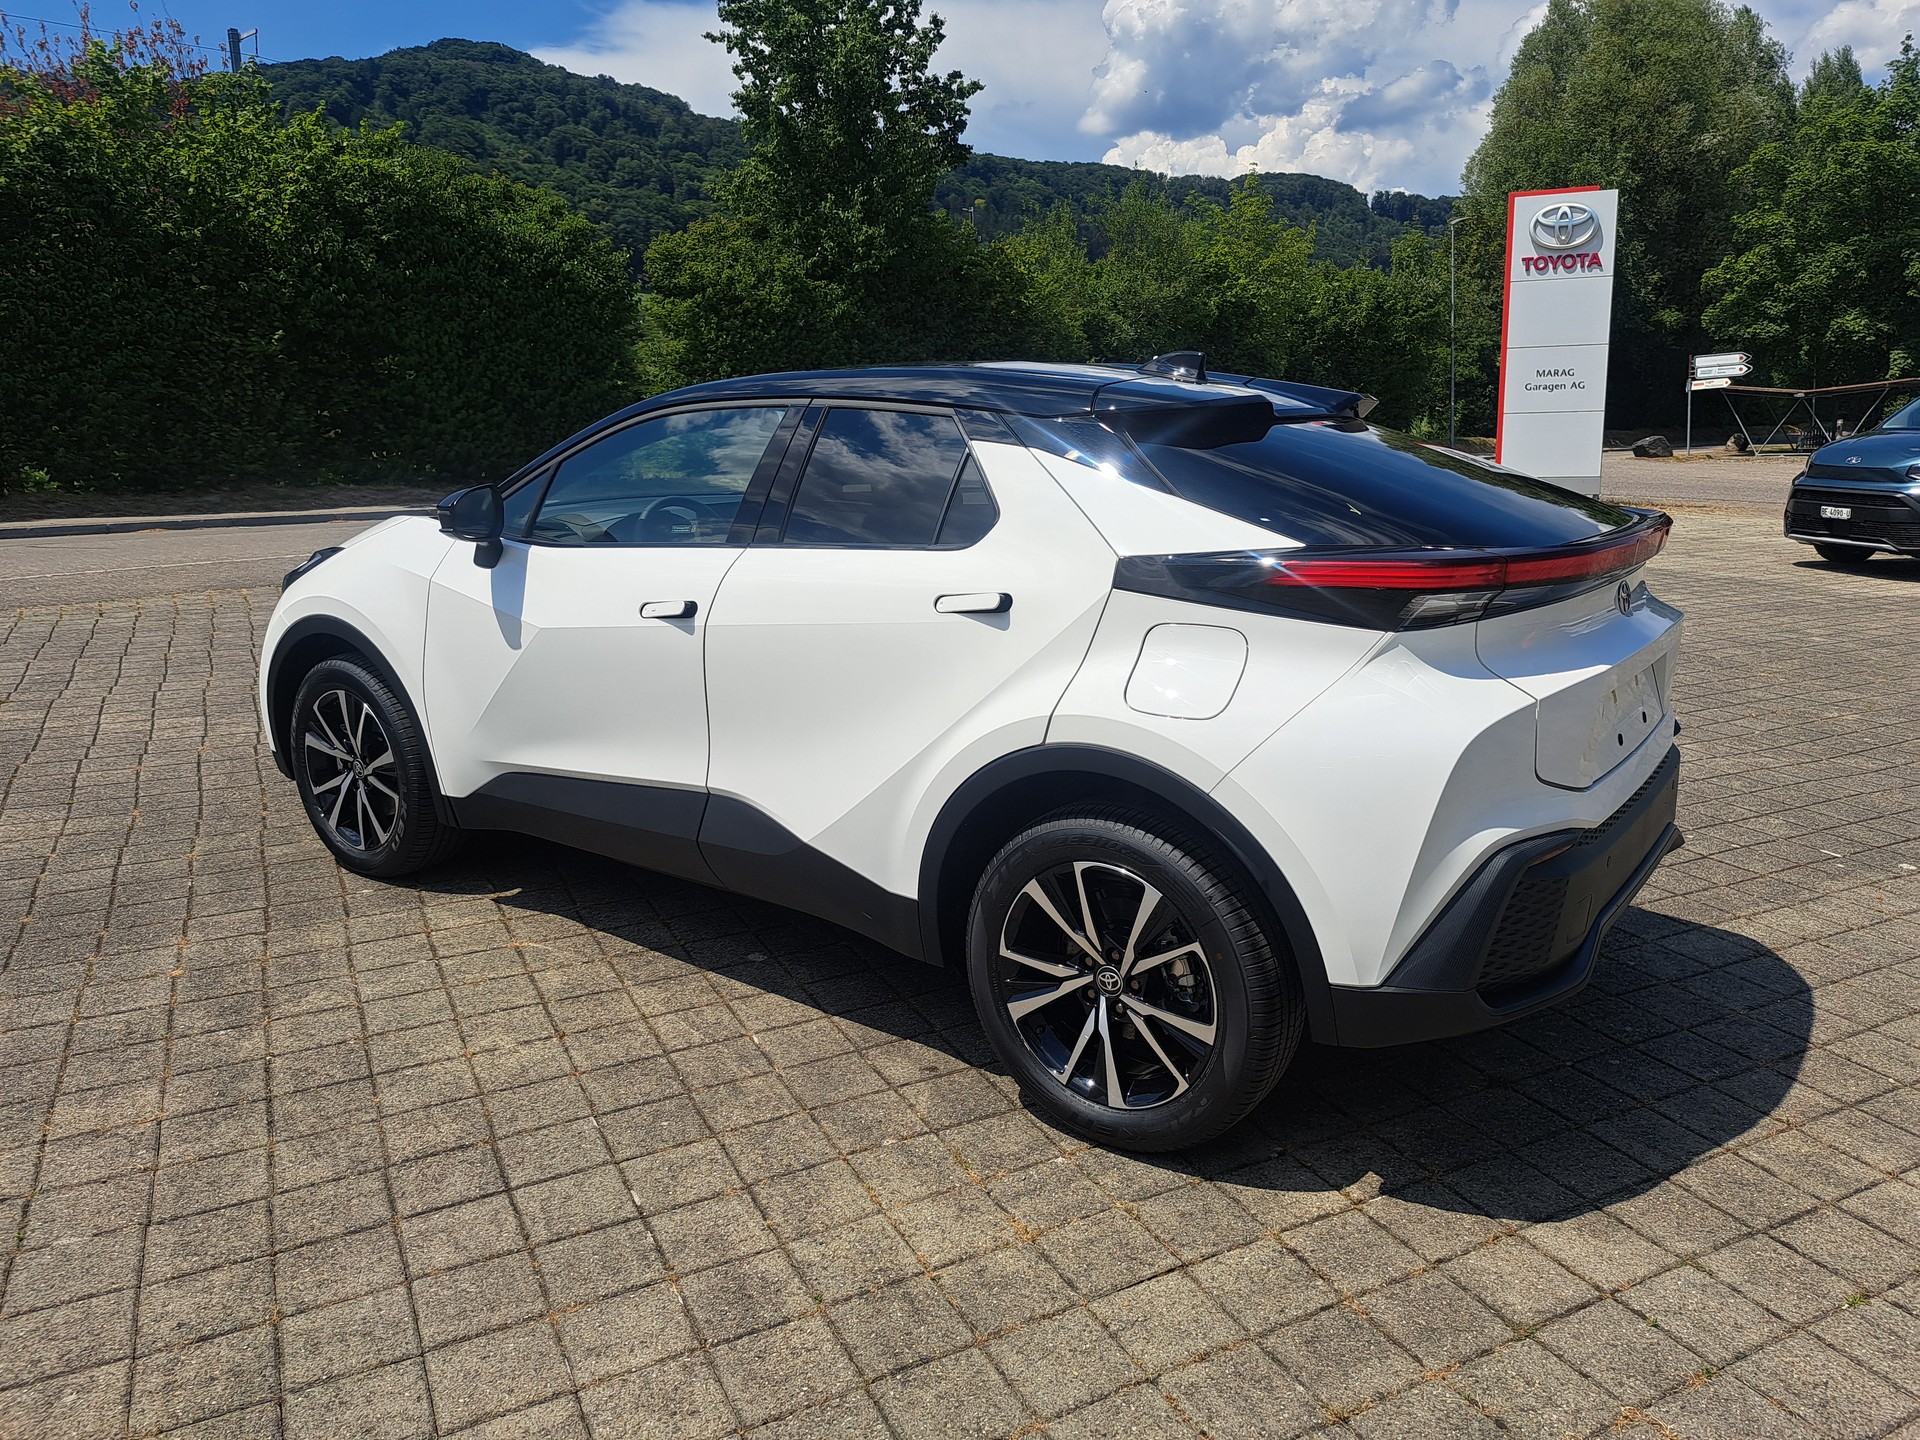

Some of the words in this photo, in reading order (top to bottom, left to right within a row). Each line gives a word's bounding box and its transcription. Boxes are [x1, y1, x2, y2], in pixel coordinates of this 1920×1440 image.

[1522, 252, 1602, 272] TOYOTA
[1536, 368, 1575, 378] MARAG
[1524, 382, 1566, 392] Garagen
[1570, 381, 1585, 390] AG
